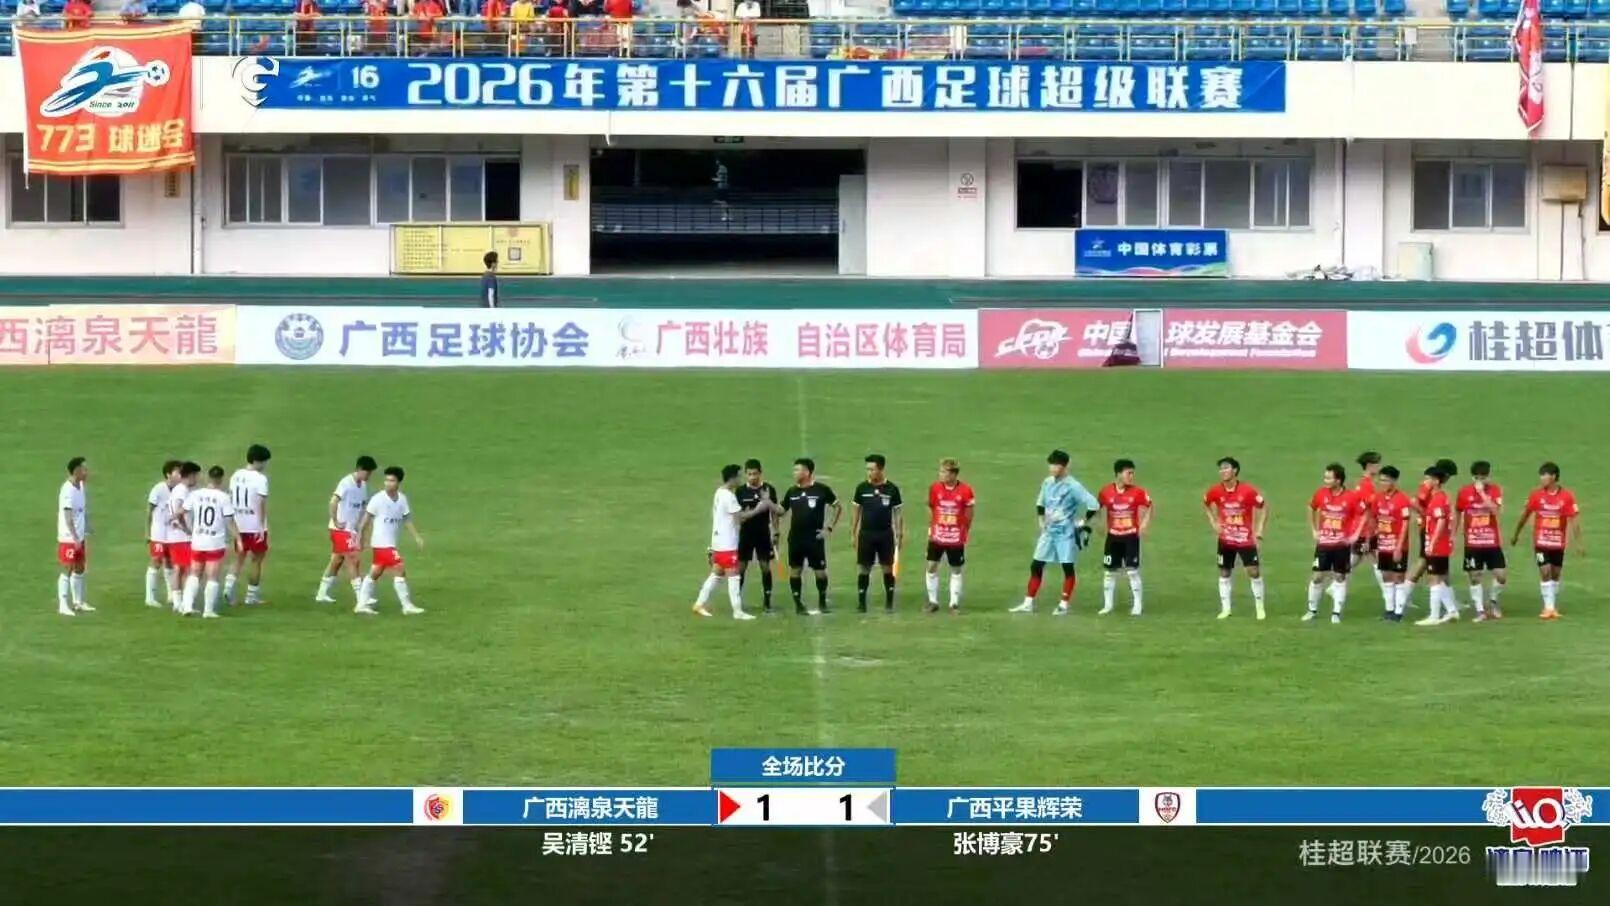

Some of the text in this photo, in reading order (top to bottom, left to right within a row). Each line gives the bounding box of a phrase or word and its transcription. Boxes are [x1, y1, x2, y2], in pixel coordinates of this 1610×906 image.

[352, 64, 380, 89] 16
[407, 62, 1243, 109] 2026年第十六届广西足球超级联赛
[89, 100, 112, 109] Since
[37, 119, 185, 154] 773 球迷会
[1117, 241, 1218, 256] 中国体育彩票
[338, 320, 590, 358] 广西足球协会
[656, 320, 769, 357] 广西壮族
[797, 322, 967, 359] 自治区体育局
[1468, 320, 1610, 361] 桂超体
[236, 485, 248, 508] 11
[199, 505, 215, 527] 10
